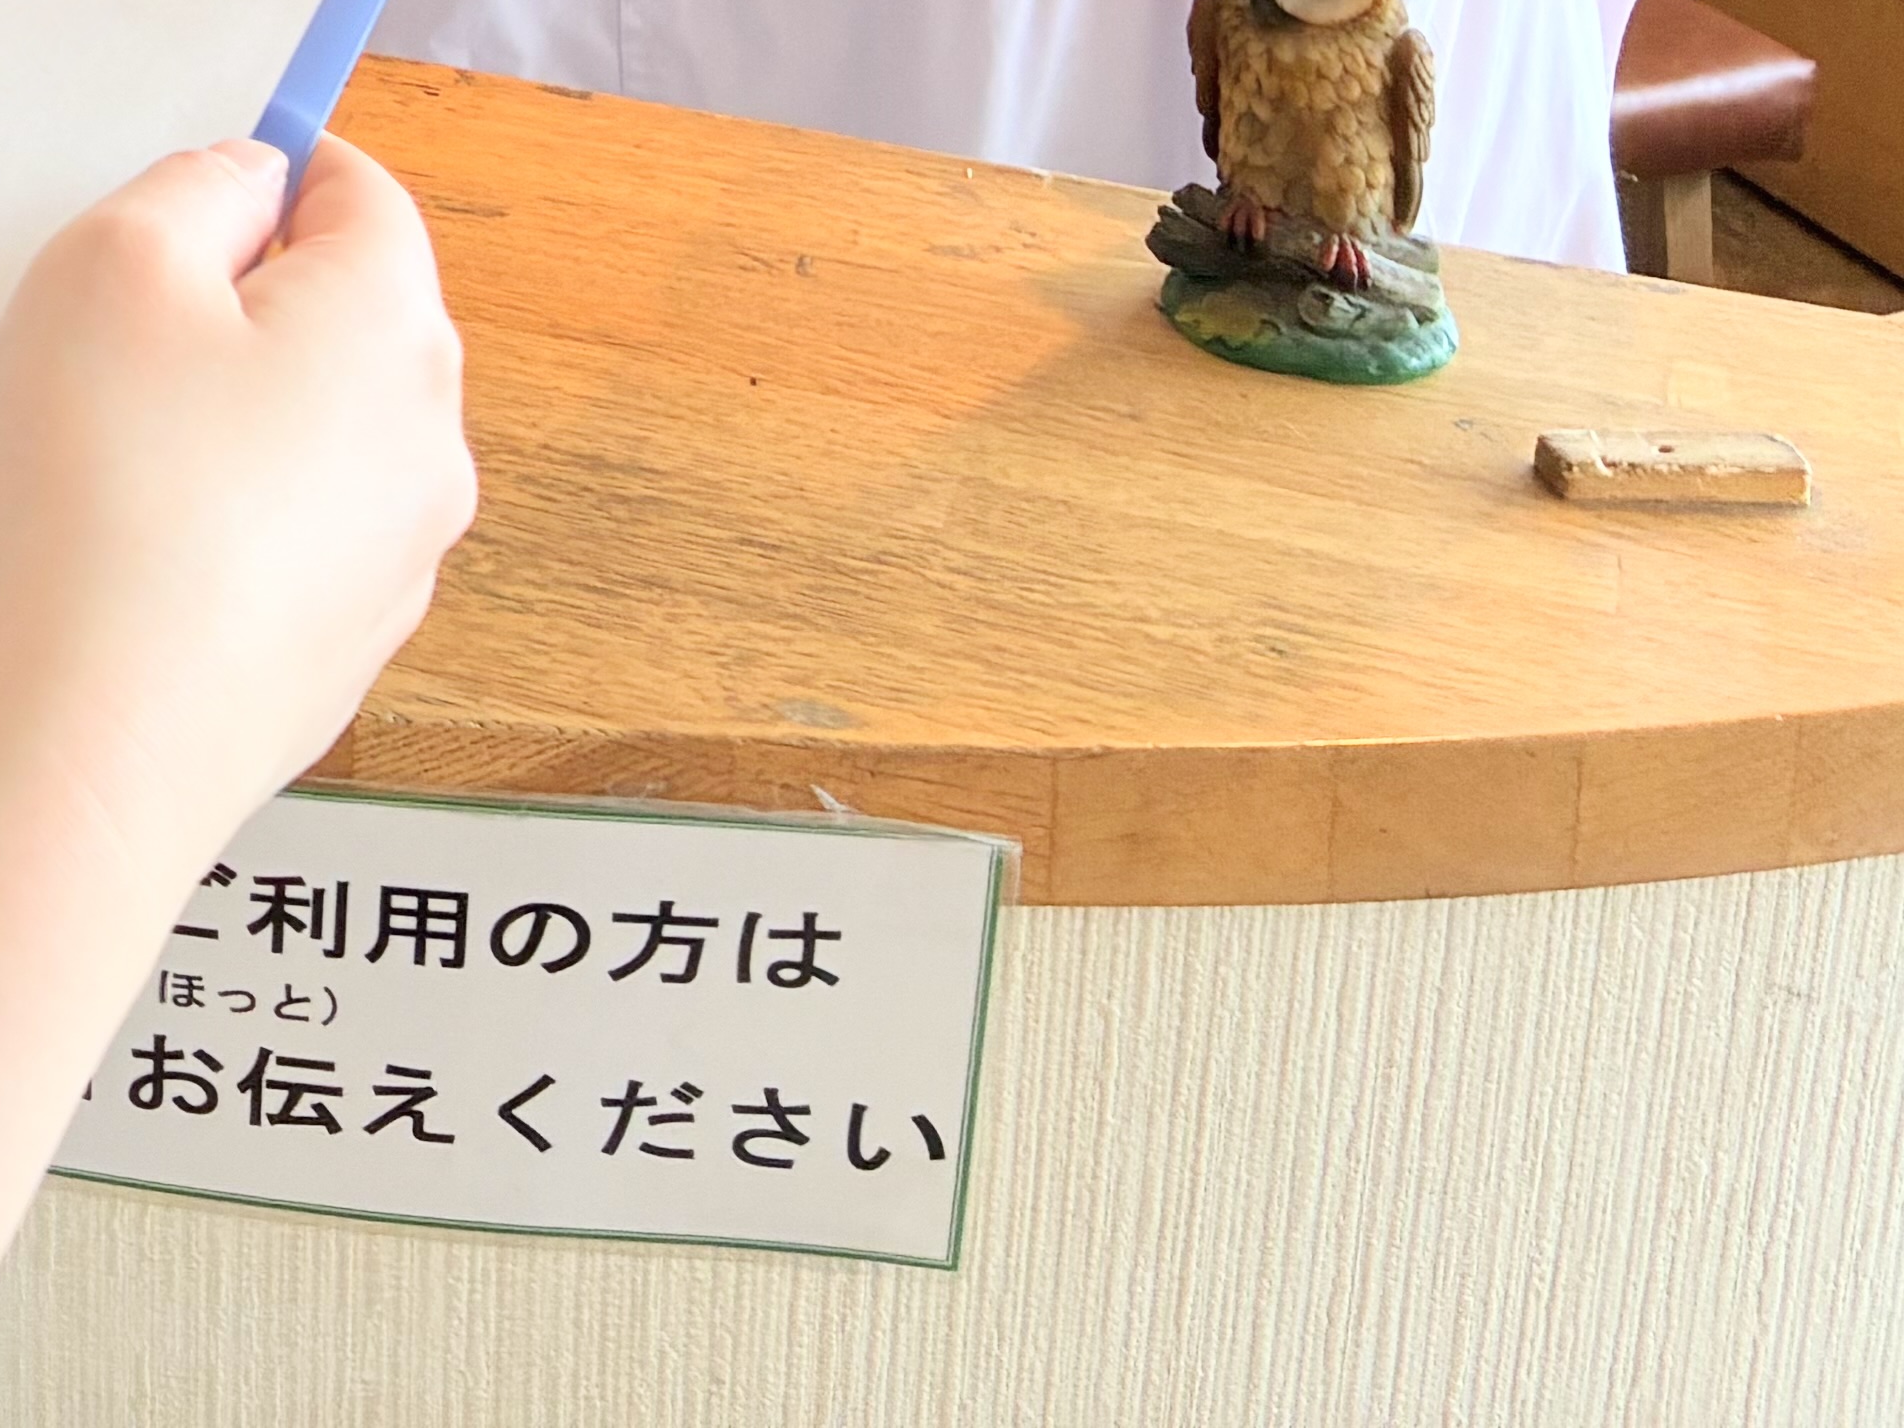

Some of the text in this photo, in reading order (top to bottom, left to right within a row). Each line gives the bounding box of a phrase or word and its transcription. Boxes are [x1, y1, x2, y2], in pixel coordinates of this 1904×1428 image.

[84, 1033, 946, 1172] お伝えください
